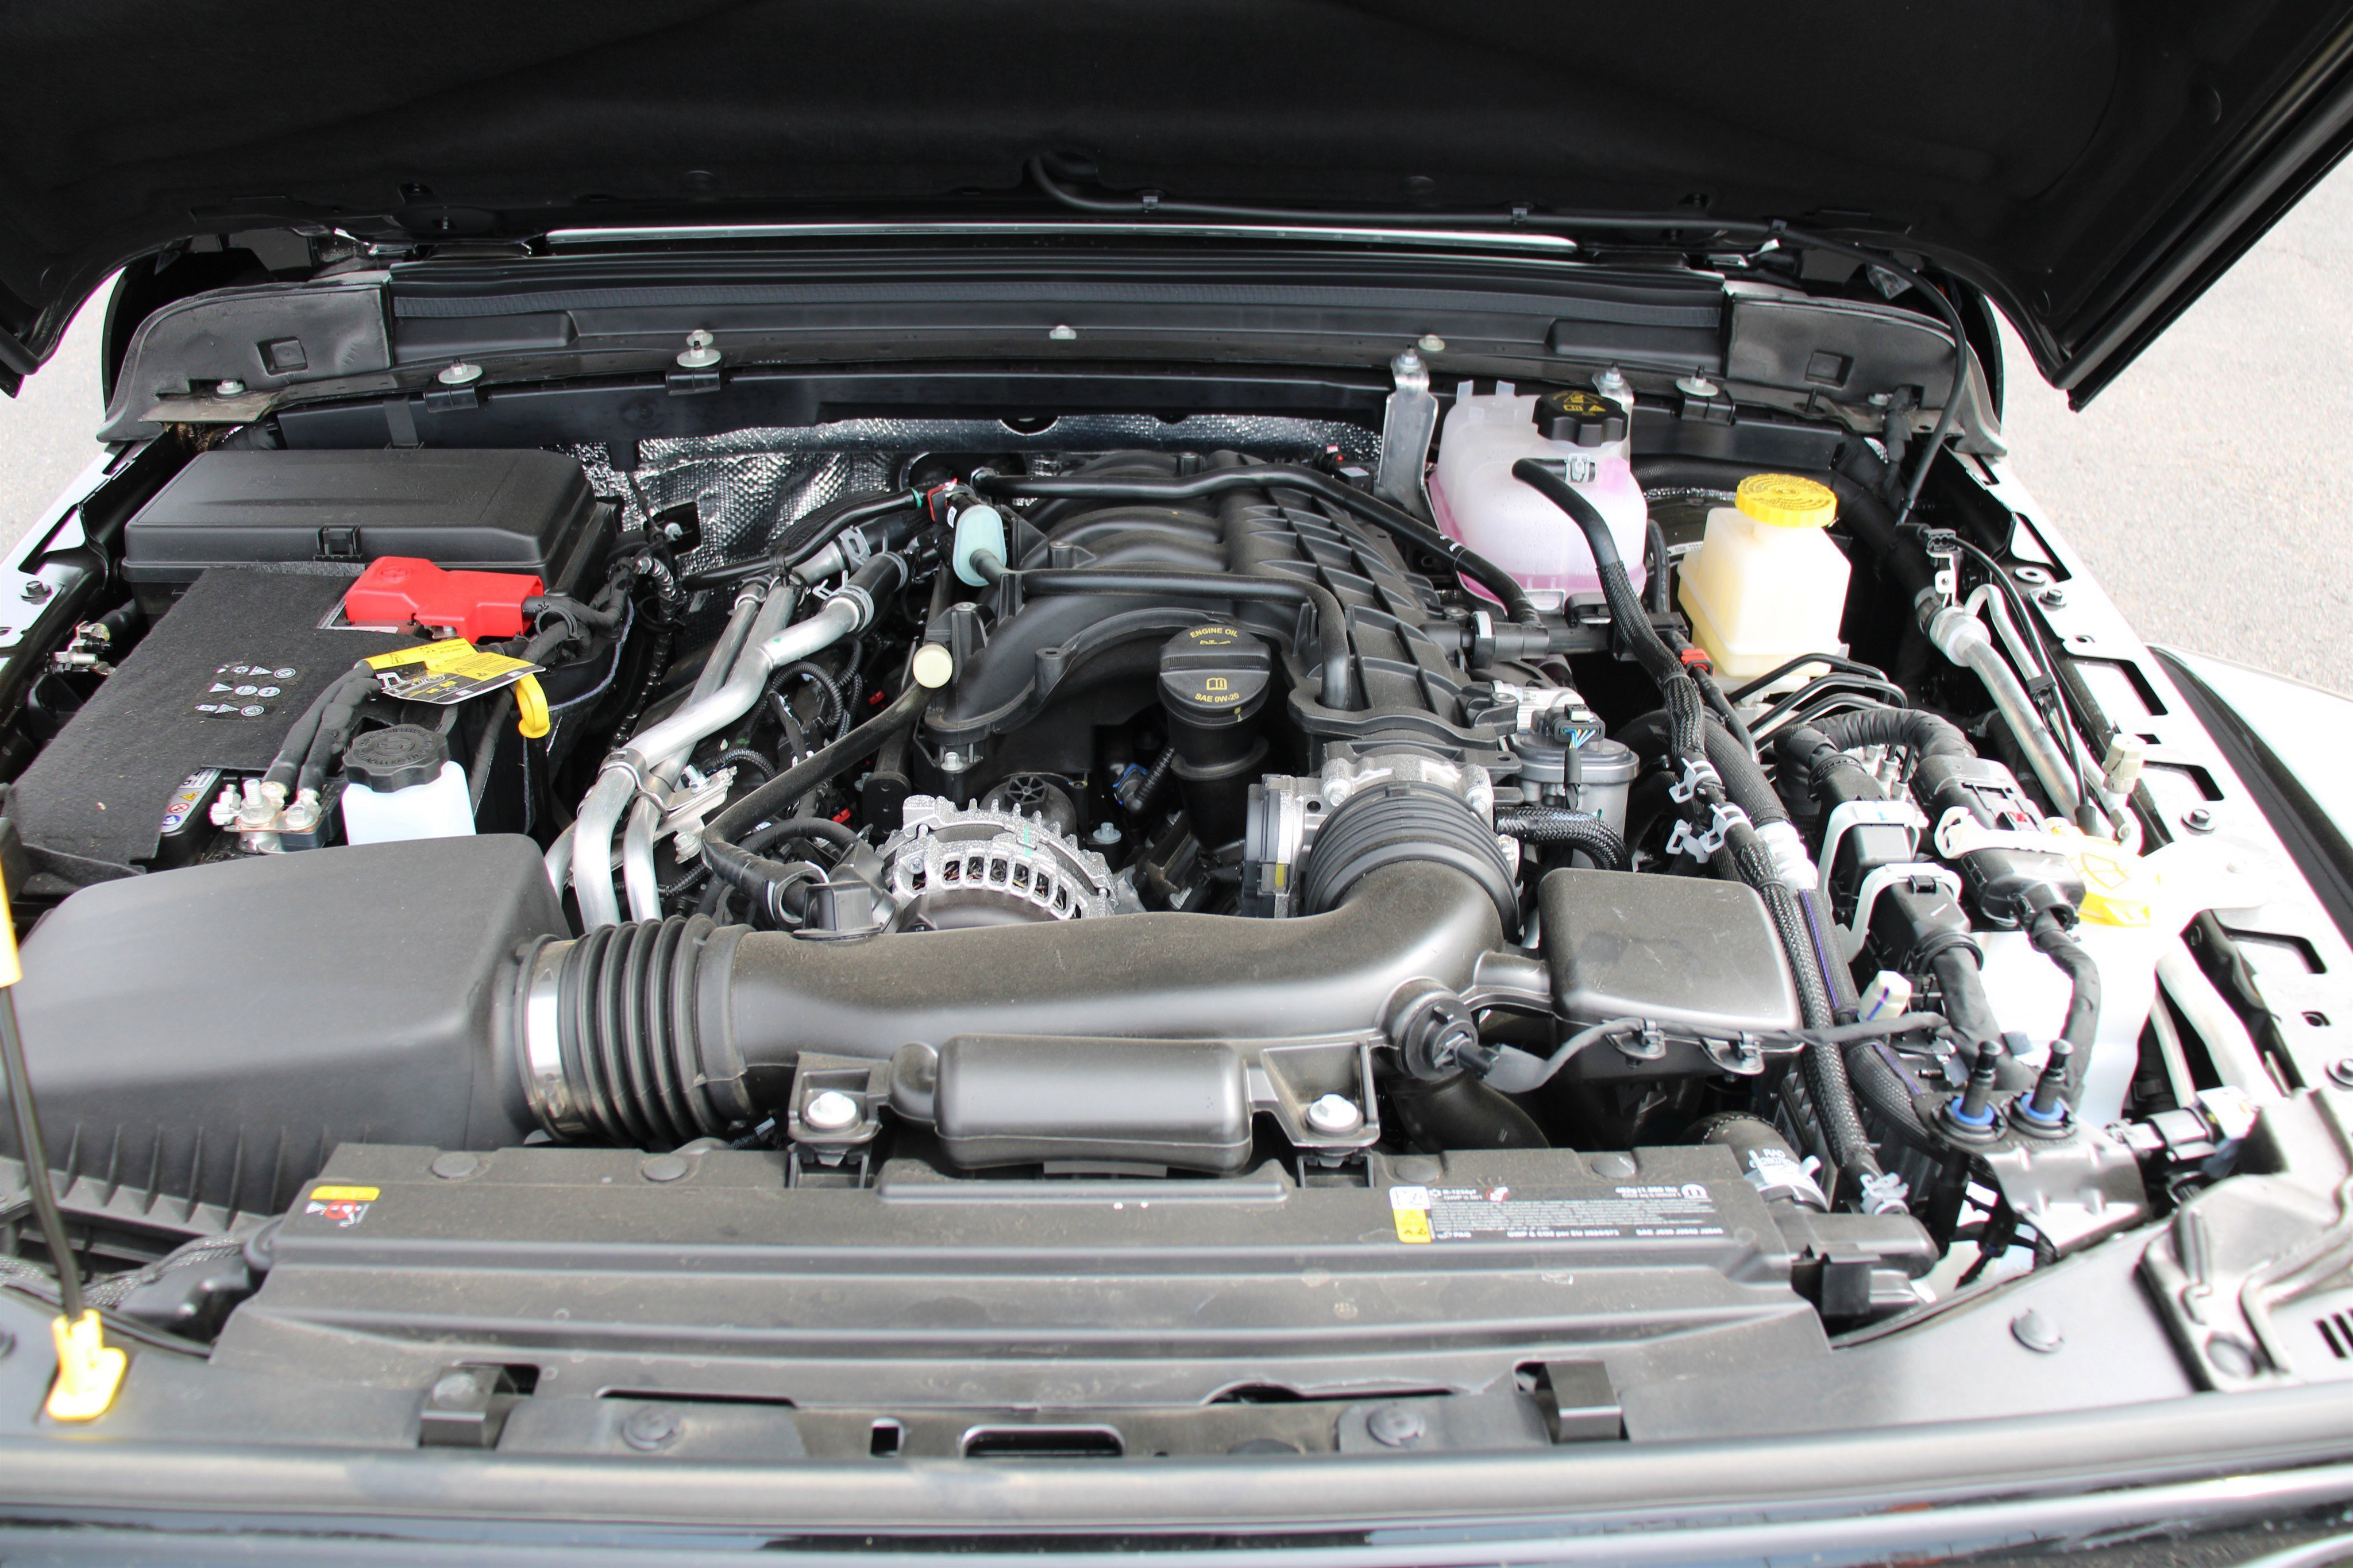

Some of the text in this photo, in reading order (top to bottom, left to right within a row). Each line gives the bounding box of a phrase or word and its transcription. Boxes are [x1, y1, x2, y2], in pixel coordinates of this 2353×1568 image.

[1190, 627, 1238, 638] ENGINE OIL
[1195, 692, 1240, 702] SAE 0W-20
